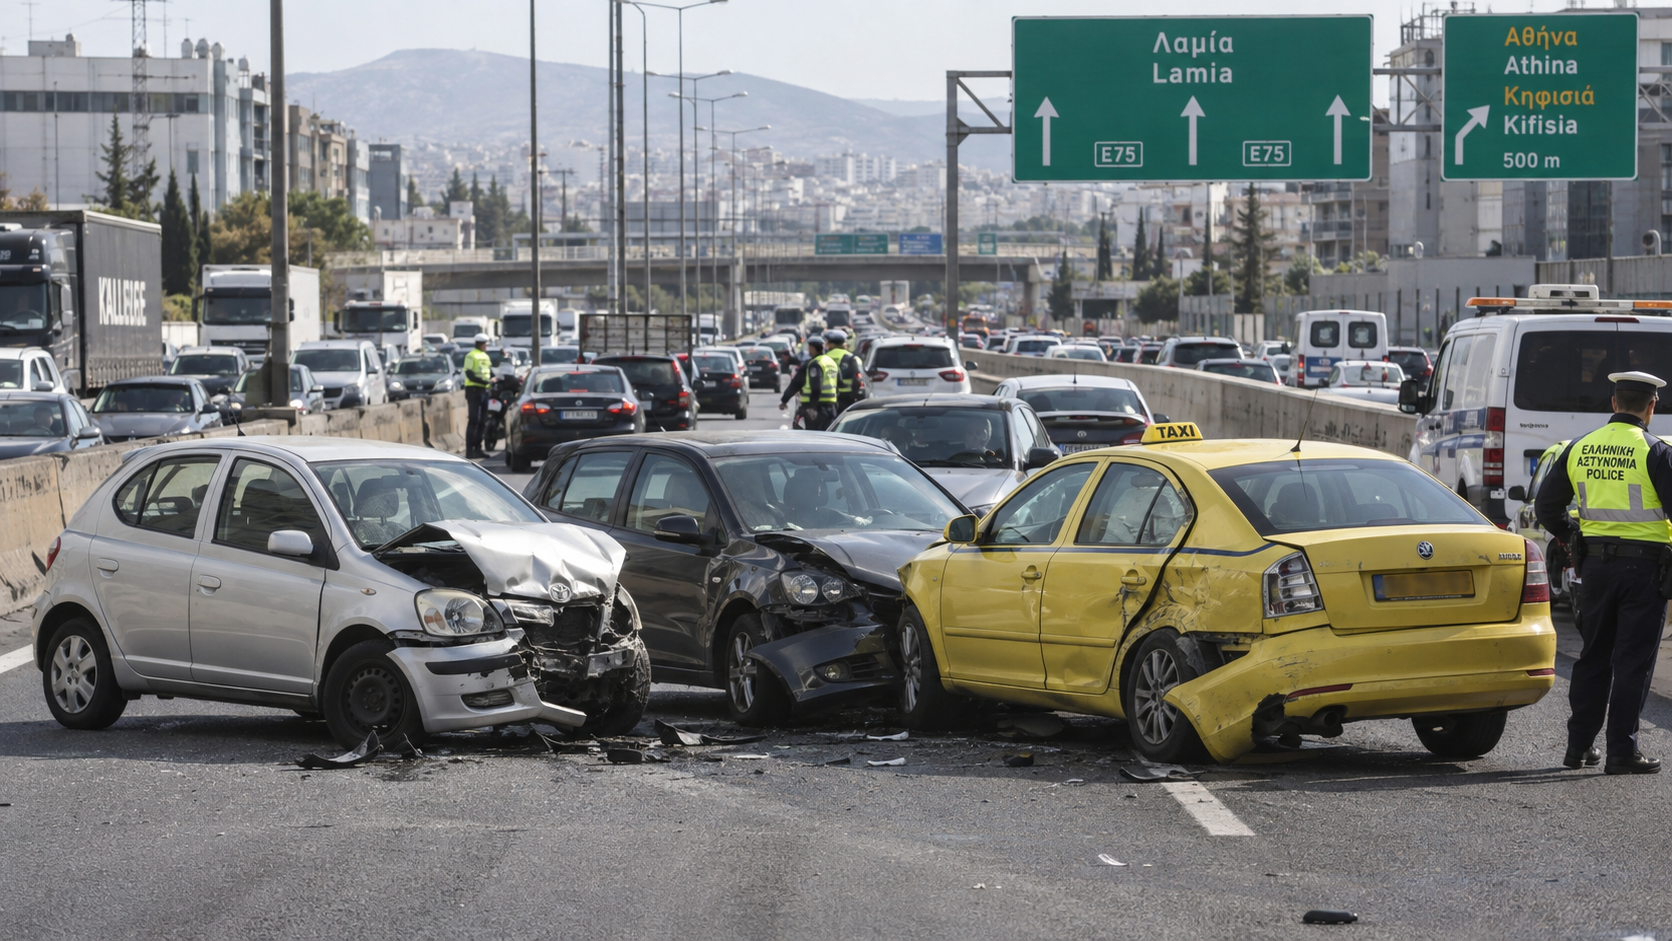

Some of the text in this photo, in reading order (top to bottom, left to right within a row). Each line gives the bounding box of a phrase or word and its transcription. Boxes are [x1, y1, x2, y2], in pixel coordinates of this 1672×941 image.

[1153, 31, 1234, 58] Λαμία
[1504, 26, 1578, 50] Αθήνα
[1153, 61, 1233, 84] Lamia
[1504, 55, 1578, 75] Athina
[1504, 85, 1595, 110] Κηφισιά
[1504, 115, 1578, 135] Kifisia
[1101, 145, 1136, 164] E75
[1249, 144, 1285, 163] E75
[1503, 152, 1560, 169] 500 m
[1156, 425, 1196, 439] TAXI
[1581, 444, 1635, 457] ΕΛΛΗΝΙΚΗ
[1587, 469, 1625, 481] POLICE
